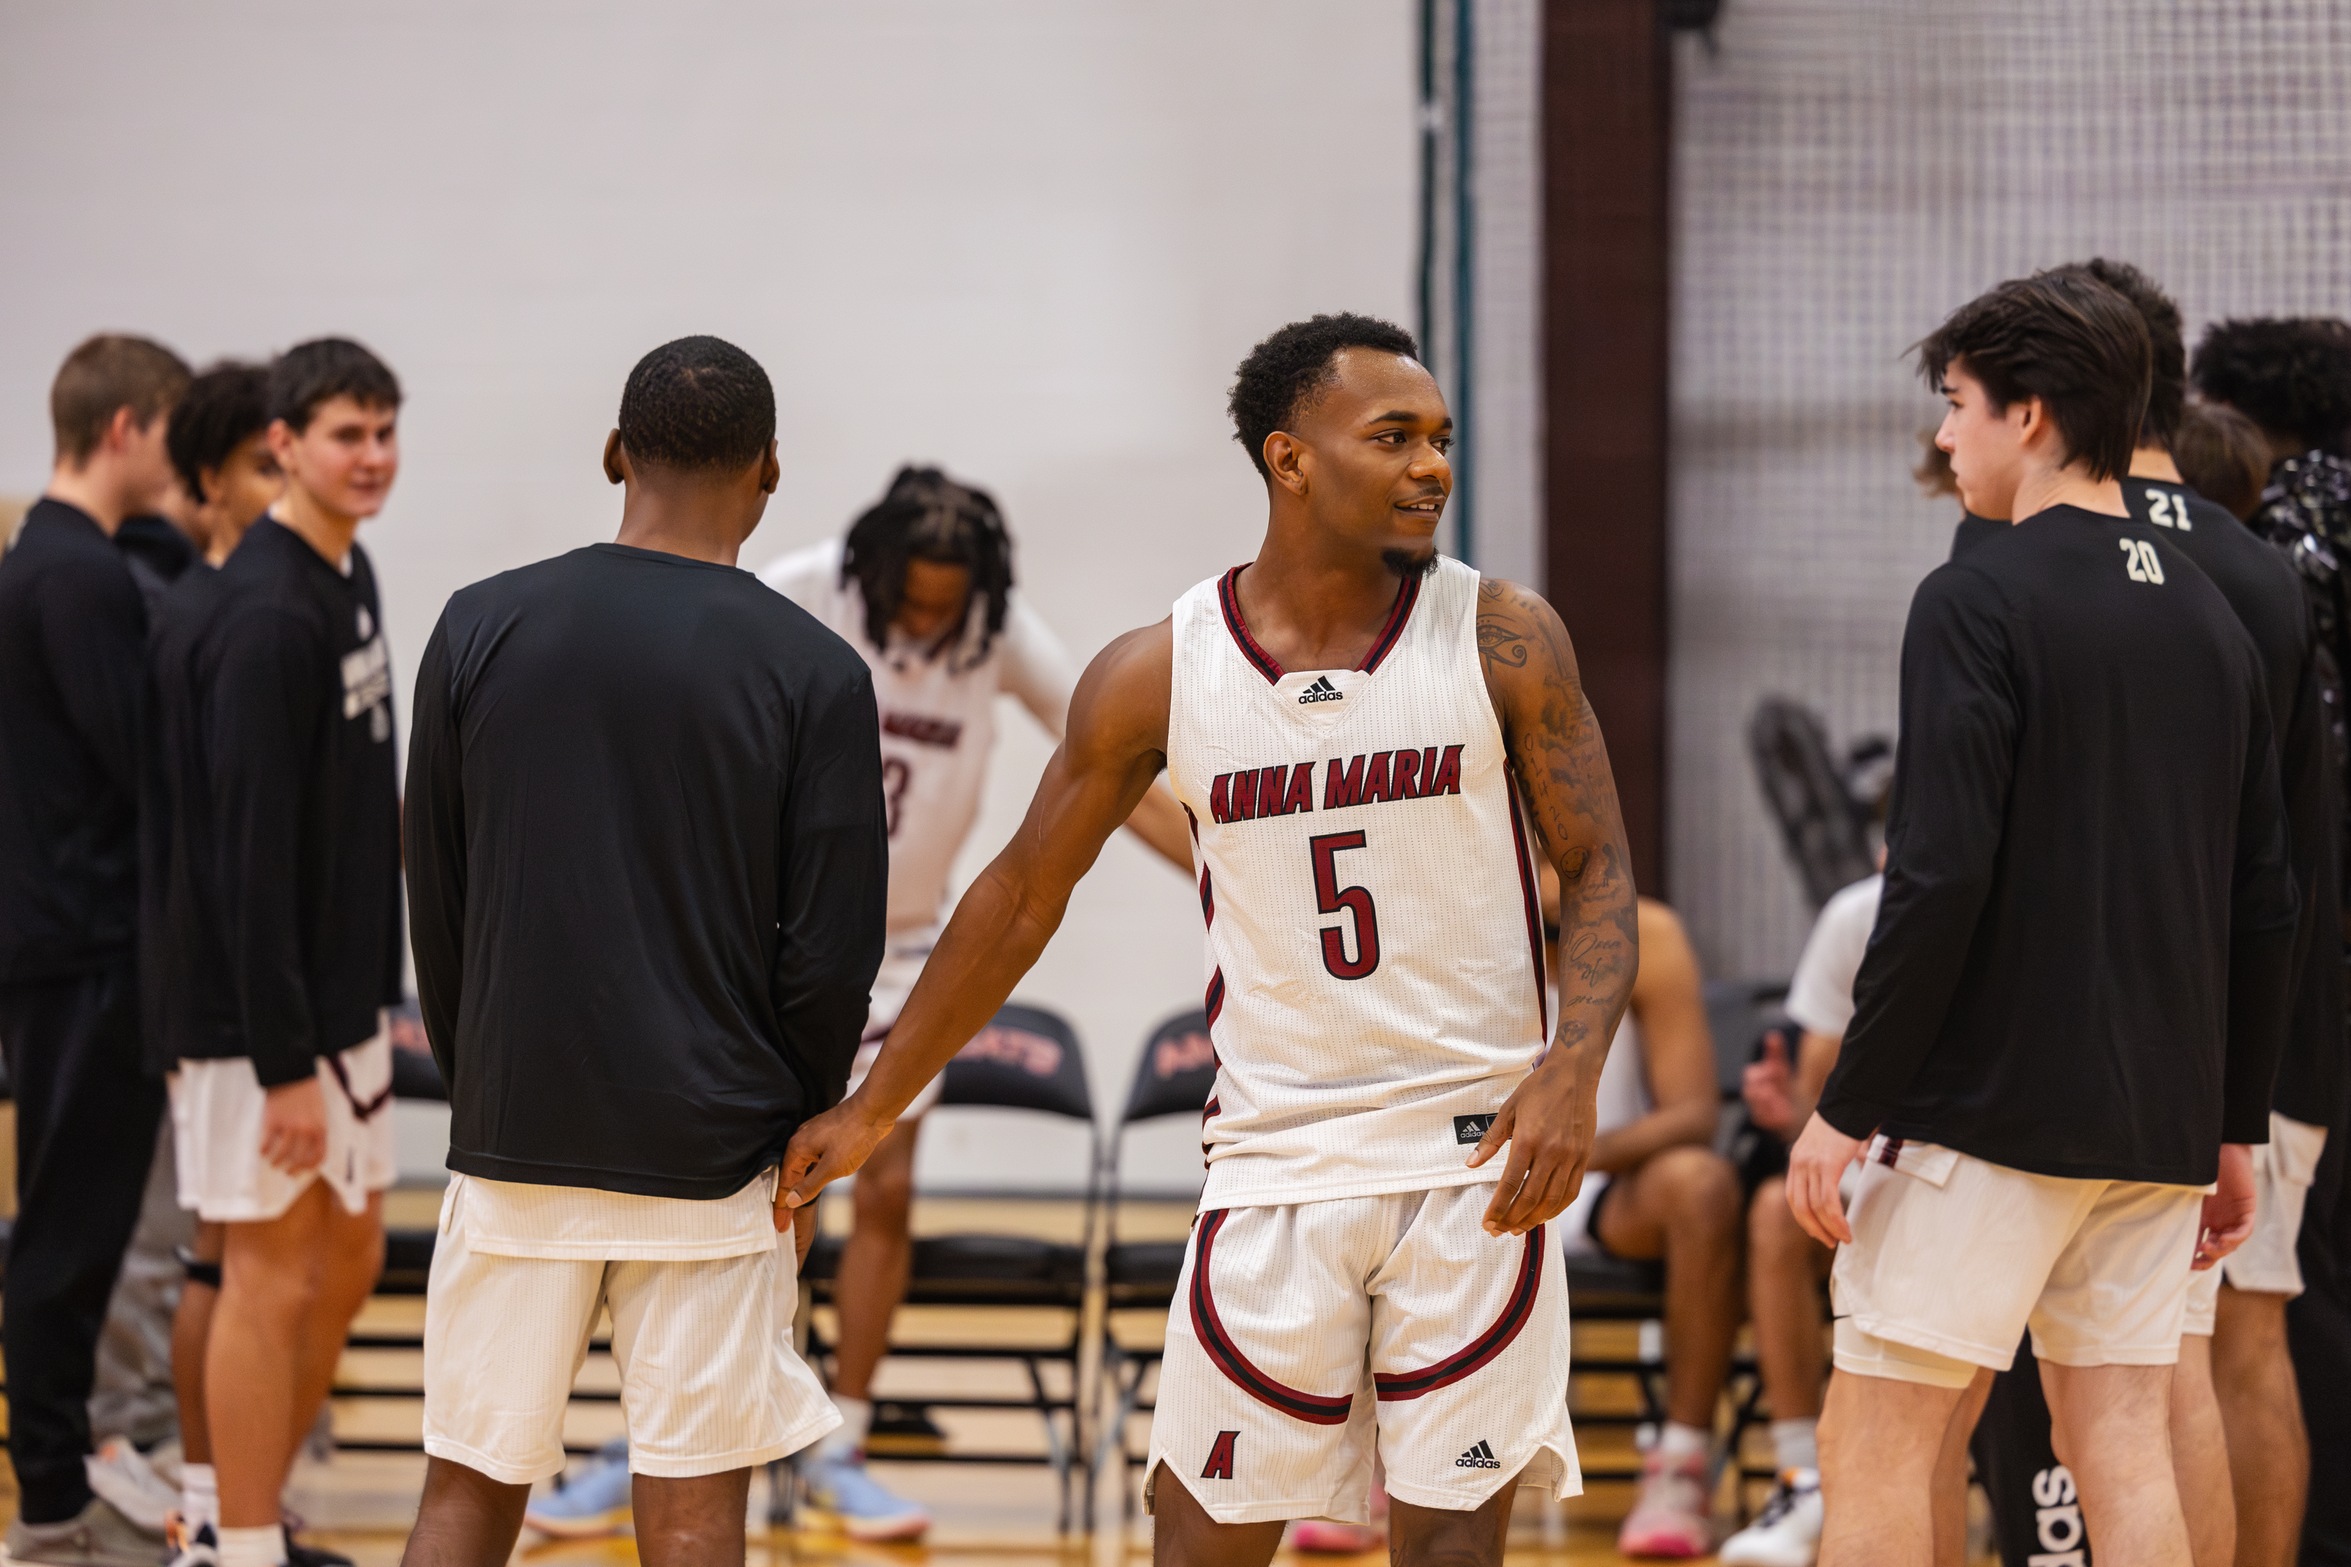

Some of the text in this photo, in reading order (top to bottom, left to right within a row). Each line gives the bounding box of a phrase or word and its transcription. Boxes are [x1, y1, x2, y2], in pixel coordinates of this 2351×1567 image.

[2145, 487, 2192, 532] 21
[2119, 537, 2165, 585] 20
[1298, 690, 1343, 704] adidas
[1210, 744, 1465, 824] ANNA MARIA
[1309, 829, 1380, 980] 5
[1200, 1430, 1241, 1479] A
[1455, 1456, 1501, 1469] adidas
